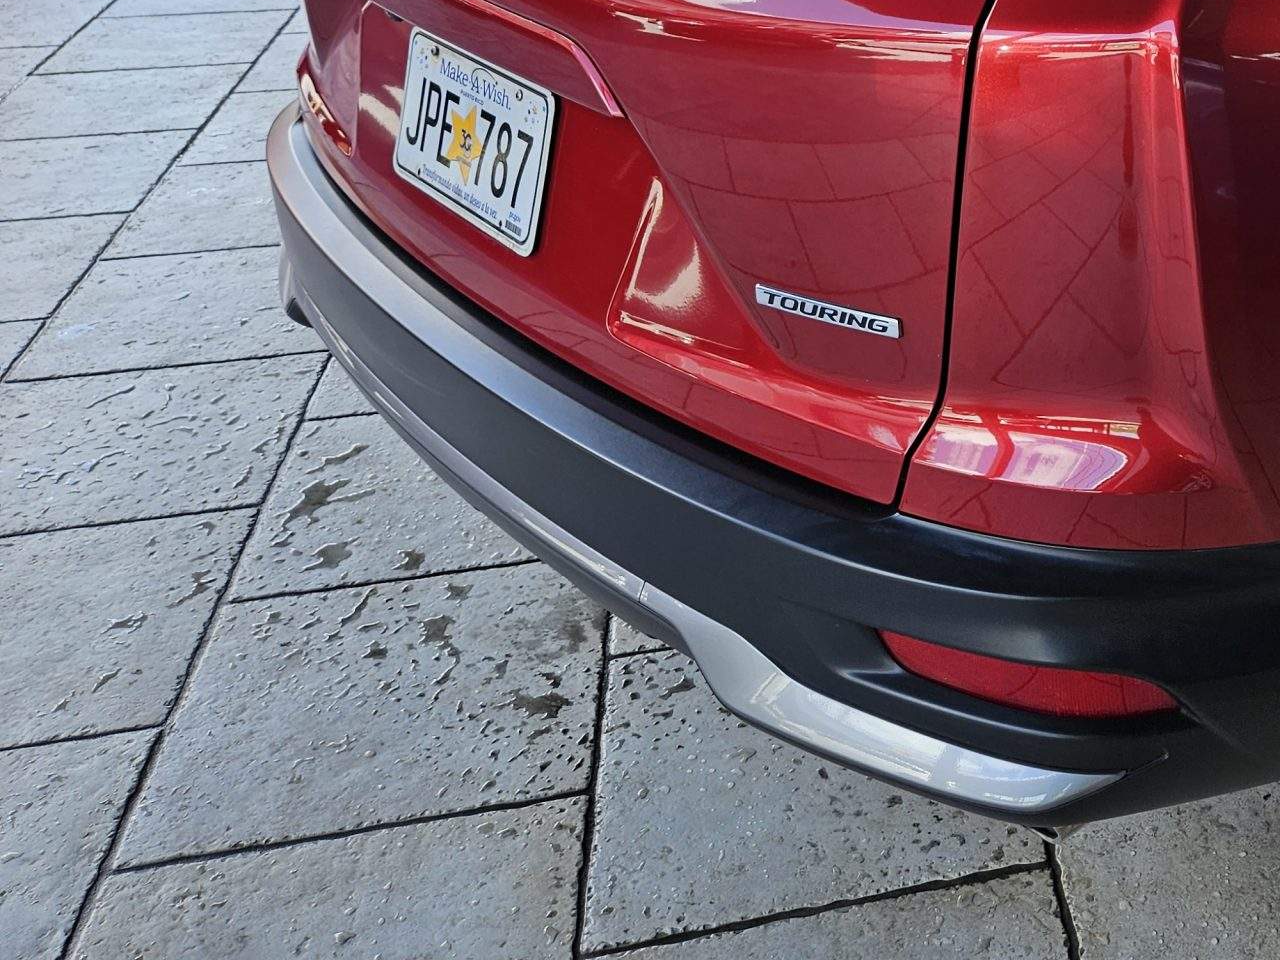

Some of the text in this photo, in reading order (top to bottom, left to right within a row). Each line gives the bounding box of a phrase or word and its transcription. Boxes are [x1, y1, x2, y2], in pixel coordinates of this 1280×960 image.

[405, 76, 534, 209] JPE 787
[763, 290, 889, 334] TOURING
